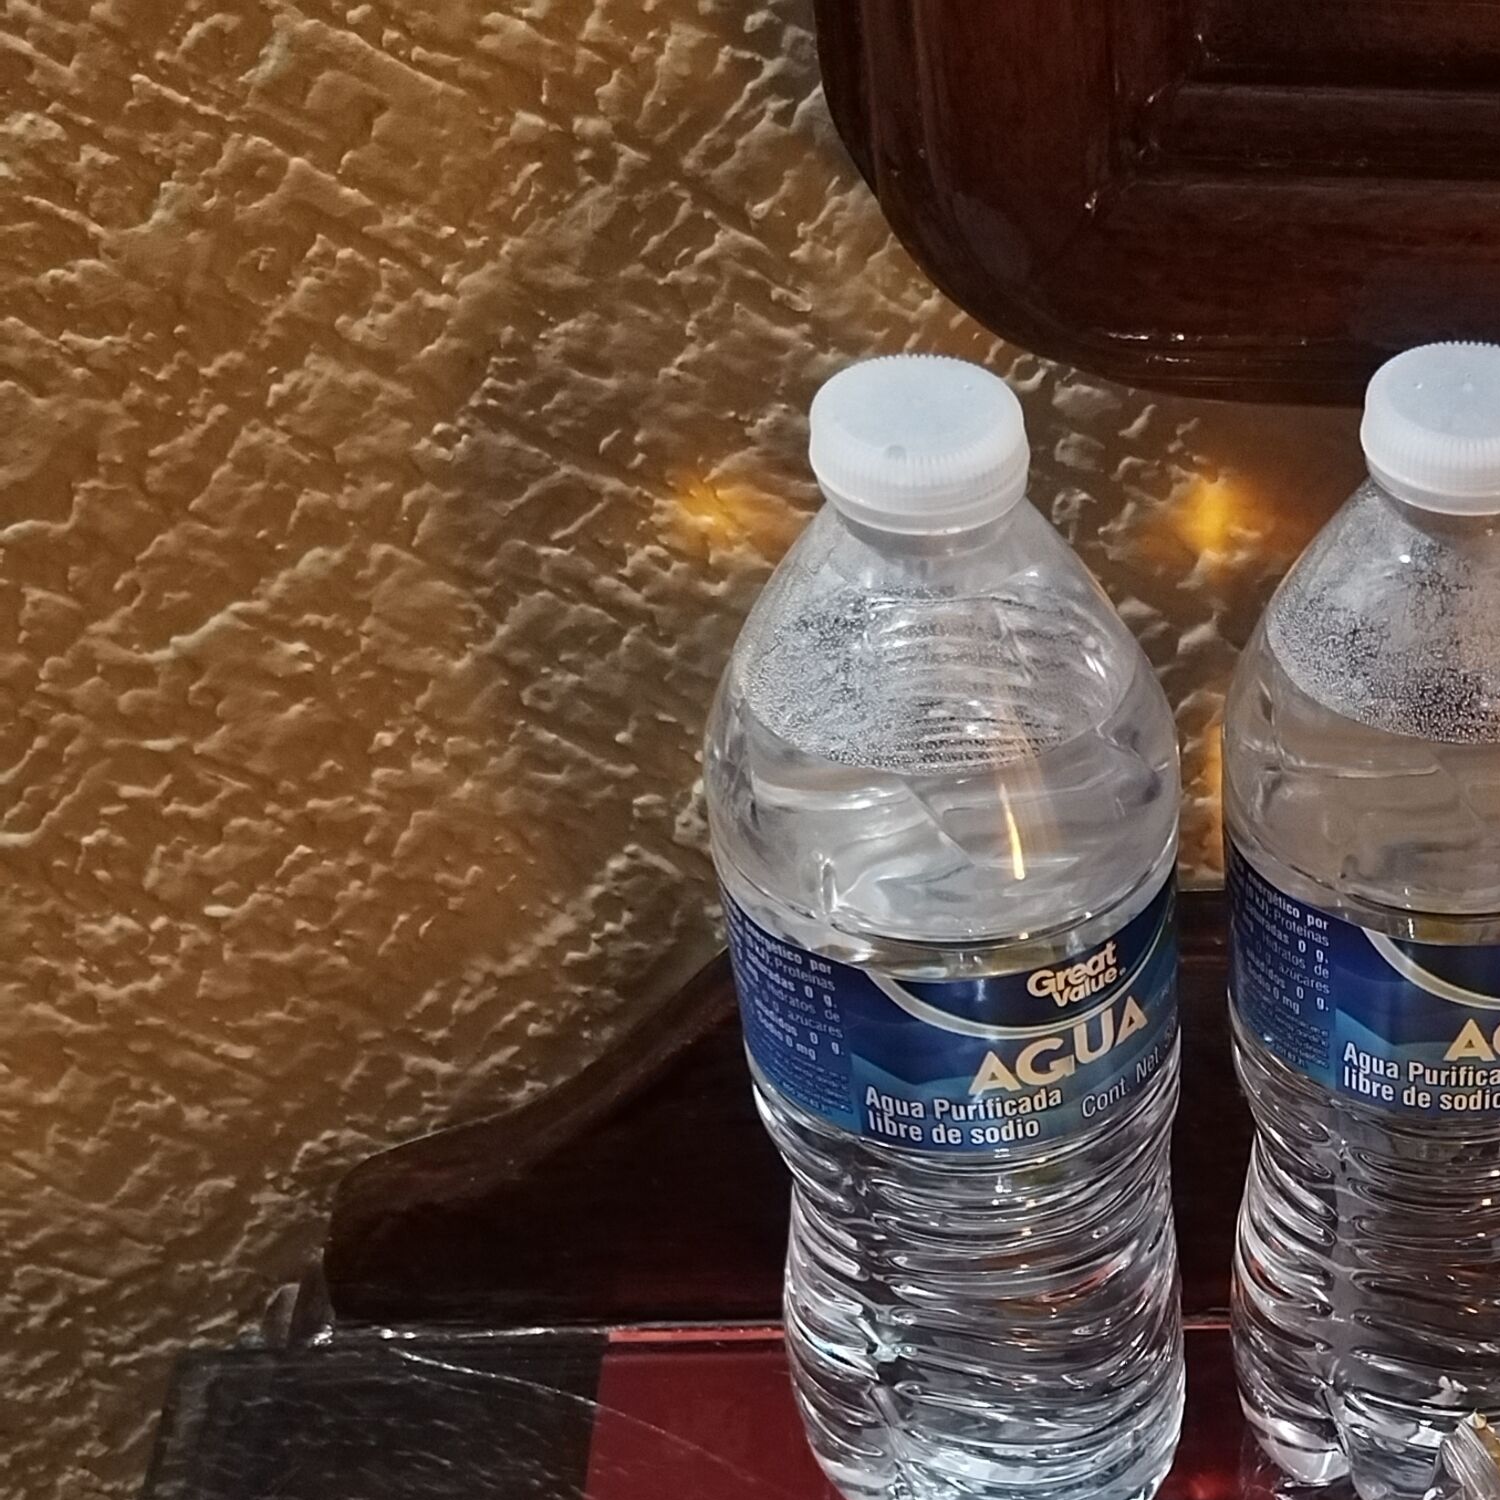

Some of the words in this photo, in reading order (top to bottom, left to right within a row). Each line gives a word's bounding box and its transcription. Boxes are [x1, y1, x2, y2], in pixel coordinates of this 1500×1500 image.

[1306, 913, 1329, 931] por
[1027, 941, 1117, 997] Great
[1052, 966, 1118, 1008] Value
[968, 995, 1148, 1096] AGUA
[1343, 1041, 1399, 1080] Agua
[865, 1085, 925, 1119] Agua
[933, 1087, 1062, 1122] Purificada
[1082, 1078, 1131, 1118] Cont.
[1343, 1066, 1395, 1102] libre
[1402, 1086, 1432, 1109] de
[868, 1109, 923, 1143] libre
[932, 1119, 962, 1145] de
[970, 1118, 1039, 1145] sodio
